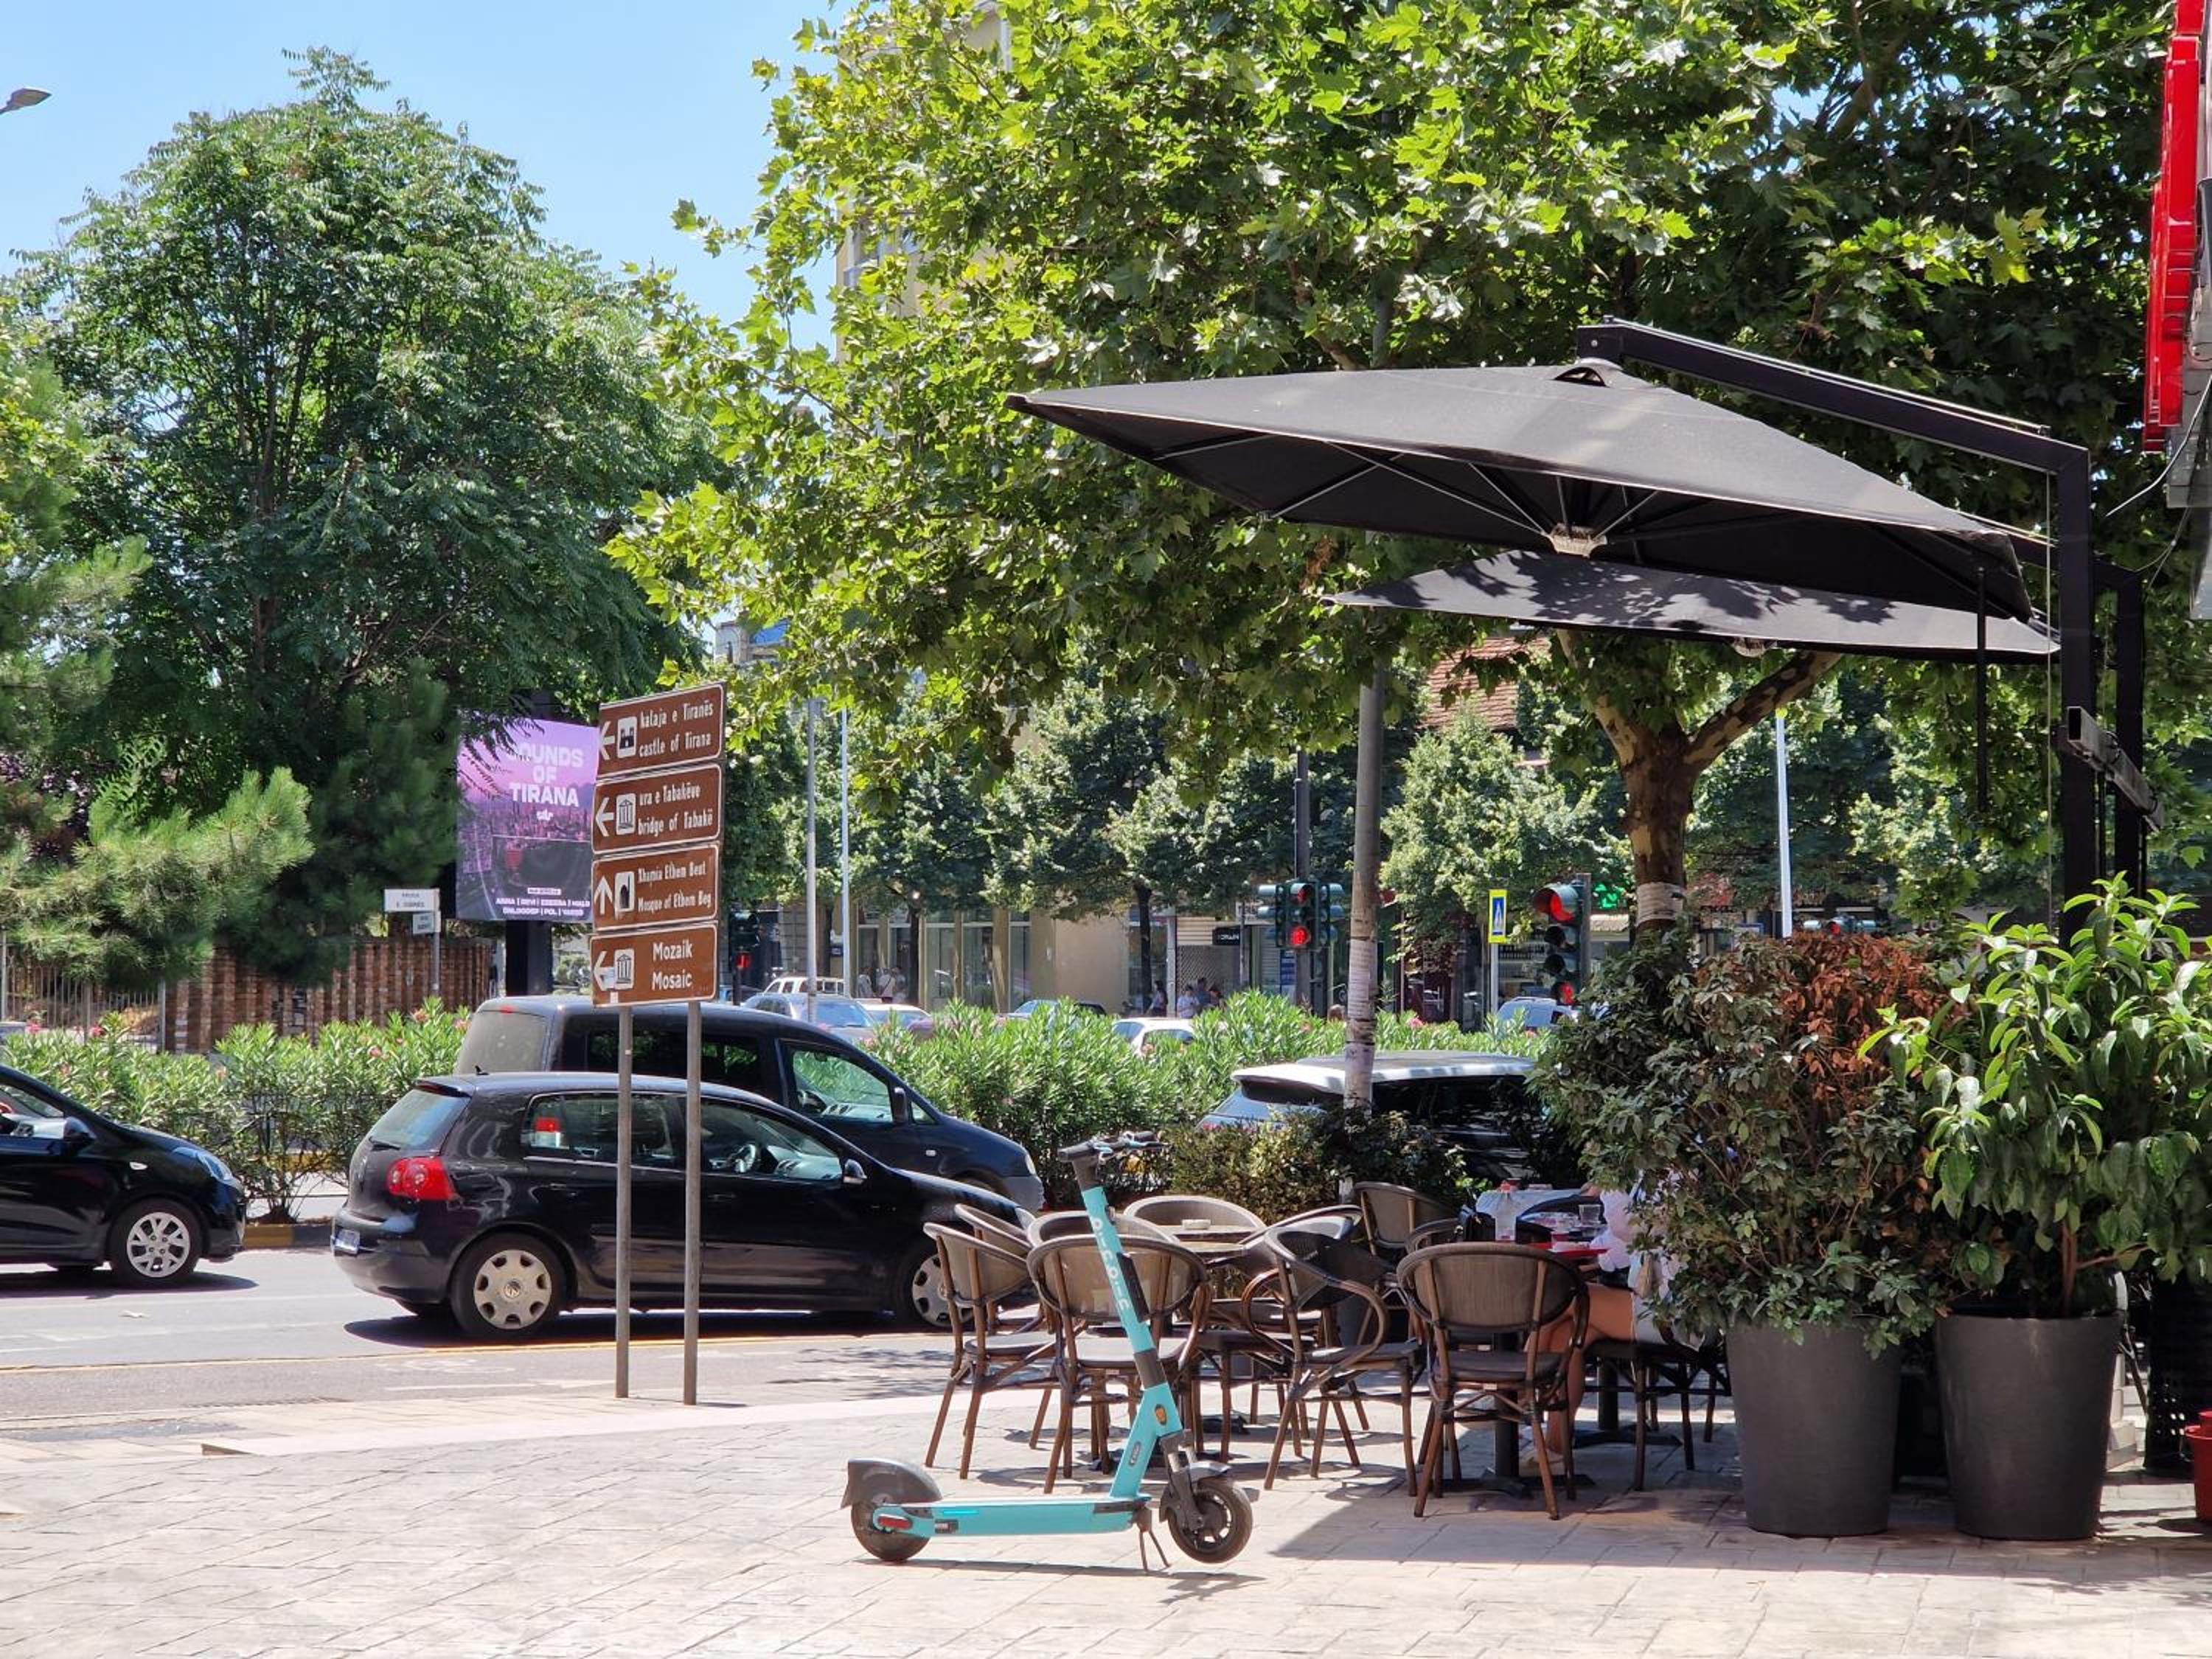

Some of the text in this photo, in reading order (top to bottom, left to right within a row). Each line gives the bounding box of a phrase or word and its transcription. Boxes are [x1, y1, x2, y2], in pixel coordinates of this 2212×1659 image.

[672, 710, 678, 723] e
[684, 700, 713, 720] Tiranës
[639, 731, 712, 757] castle of Tirana
[533, 765, 557, 784] OF
[509, 782, 580, 807] TIRANA
[639, 782, 700, 806] ura e Tabakëve
[638, 808, 713, 836] bridge of Tabakë
[665, 861, 686, 880] Ethem
[638, 897, 663, 914] Mosque
[664, 893, 672, 909] of
[674, 888, 696, 908] Ethem
[653, 939, 693, 961] Mozaik
[652, 969, 693, 991] Mosaic
